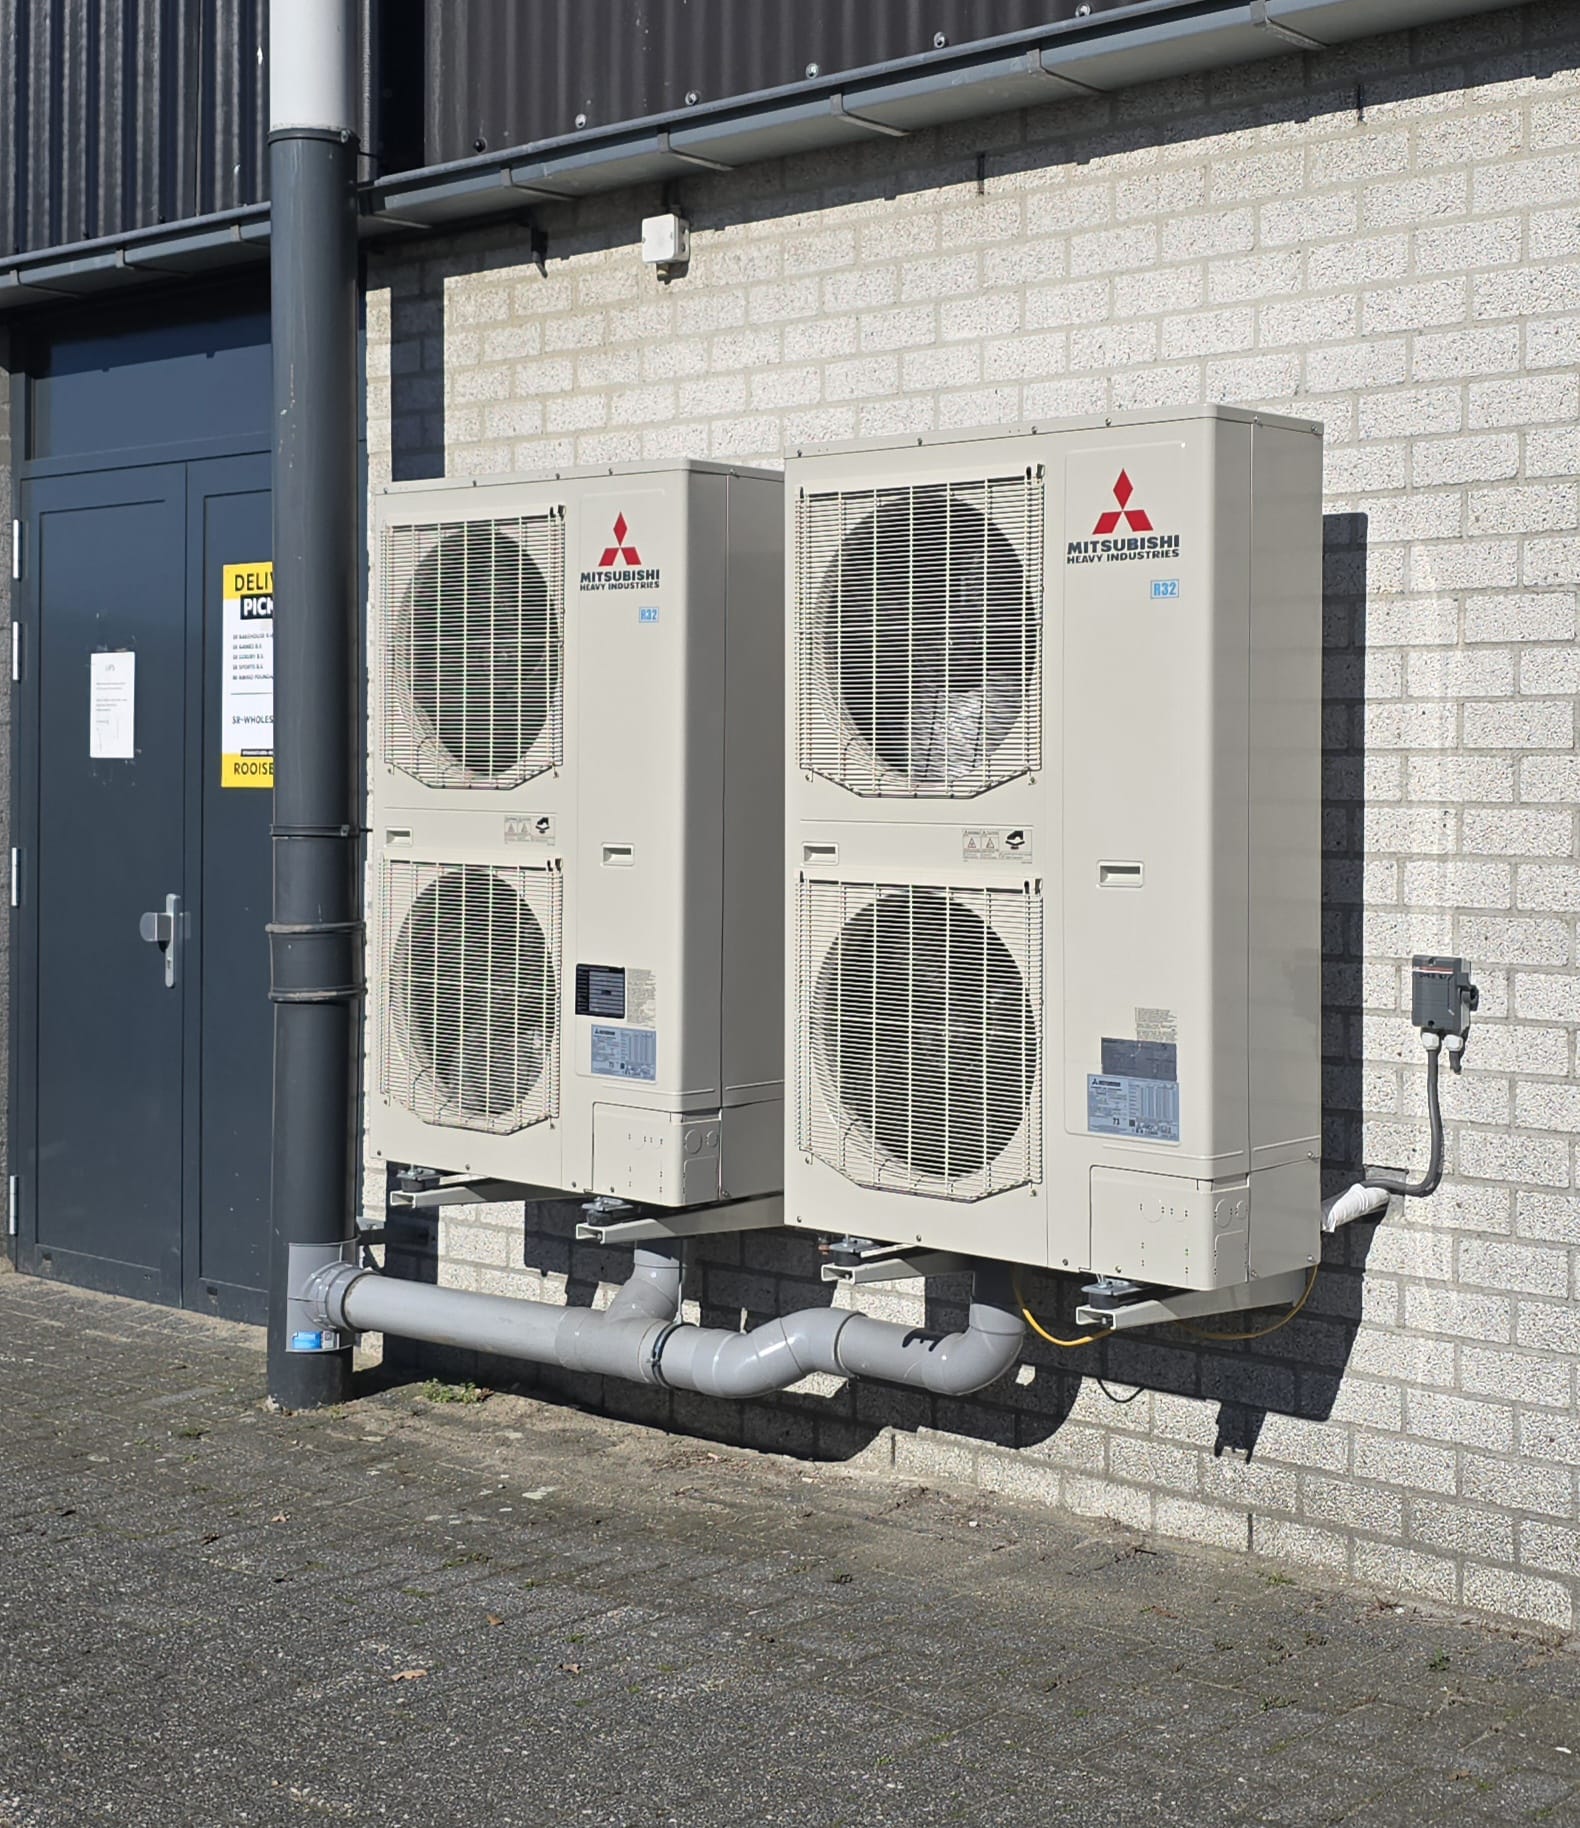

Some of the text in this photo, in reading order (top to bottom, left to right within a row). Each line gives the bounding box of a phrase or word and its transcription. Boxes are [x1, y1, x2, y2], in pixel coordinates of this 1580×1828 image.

[1067, 535, 1180, 555] MITSUBISHI
[1067, 549, 1180, 564] HEAVY INDUSTRIES
[580, 569, 660, 583] MITSUBISHI
[580, 581, 660, 592] HEAVY INDUSTRIES
[1153, 582, 1177, 596] R32
[640, 609, 657, 620] R32
